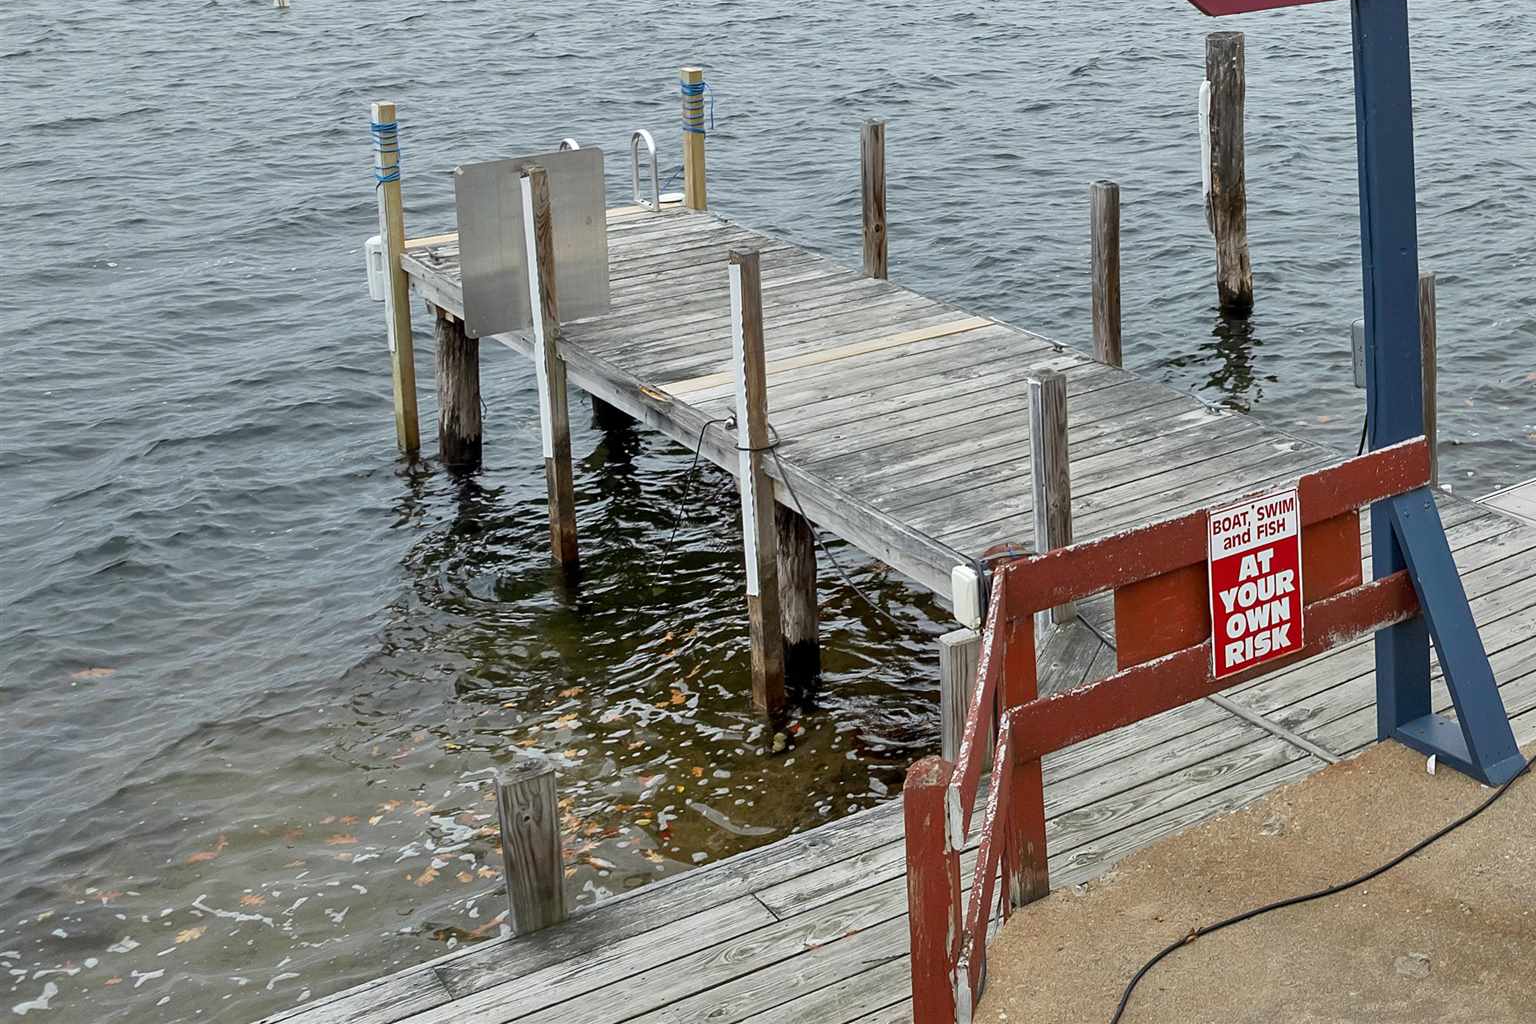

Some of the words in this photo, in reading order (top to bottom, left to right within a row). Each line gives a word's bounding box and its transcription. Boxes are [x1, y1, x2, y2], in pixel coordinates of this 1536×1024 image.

[1212, 511, 1251, 536] BOAT,
[1256, 497, 1295, 522] SWIM
[1223, 530, 1251, 550] and
[1256, 518, 1286, 540] FISH
[1238, 547, 1275, 582] AT
[1219, 568, 1295, 613] YOUR
[1225, 596, 1290, 639] OWN
[1225, 623, 1291, 668] RISK
